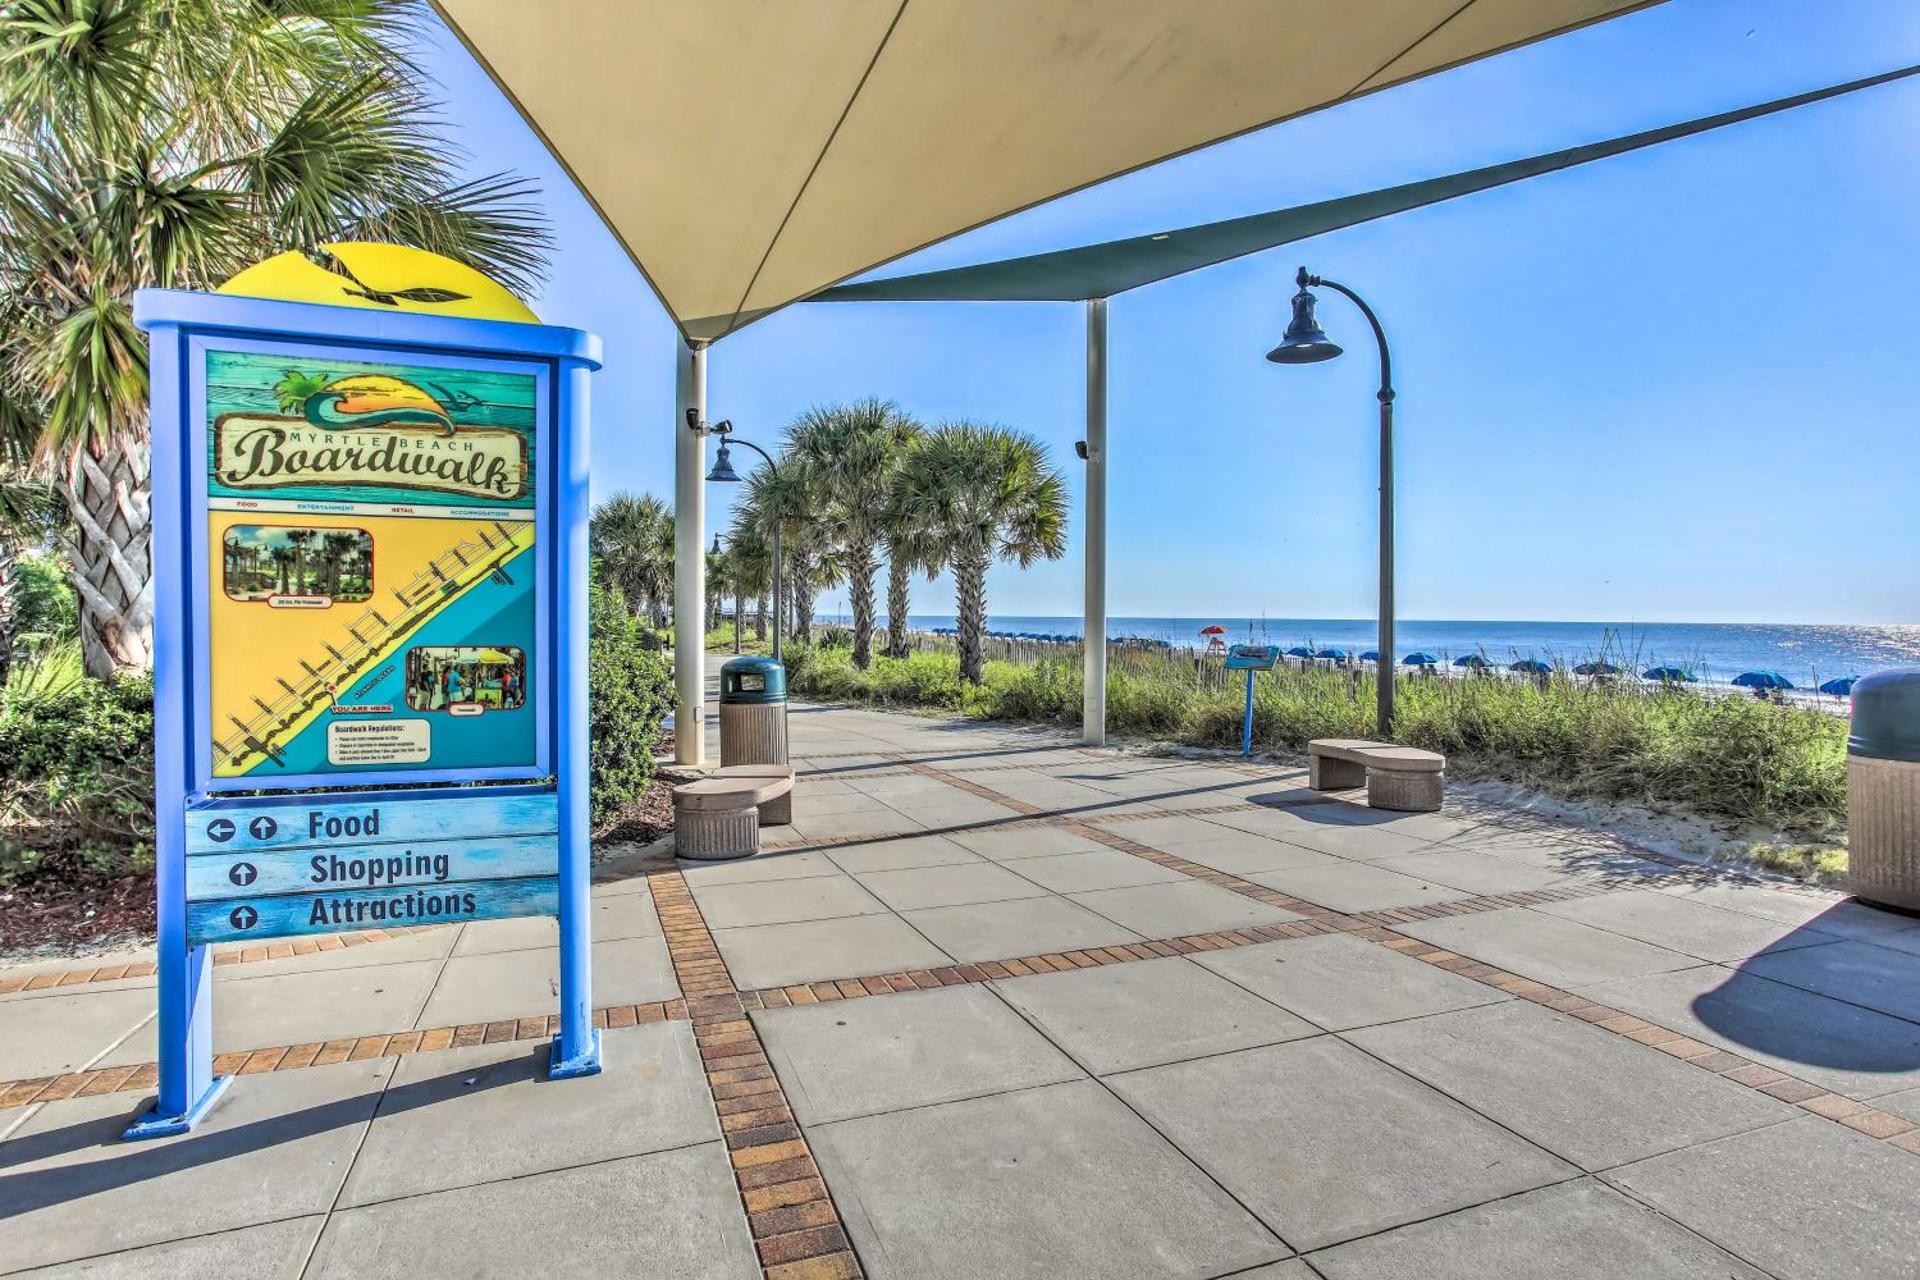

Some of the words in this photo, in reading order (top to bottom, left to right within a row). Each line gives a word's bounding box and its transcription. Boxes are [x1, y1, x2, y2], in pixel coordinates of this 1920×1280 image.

[289, 431, 381, 448] MYRTLE
[399, 437, 474, 452] BEACH
[227, 428, 512, 495] Boardwalk
[297, 503, 354, 511] ENTERTAINMENT
[309, 809, 380, 839] Food
[310, 850, 449, 885] Shopping
[309, 890, 476, 926] Attractions
